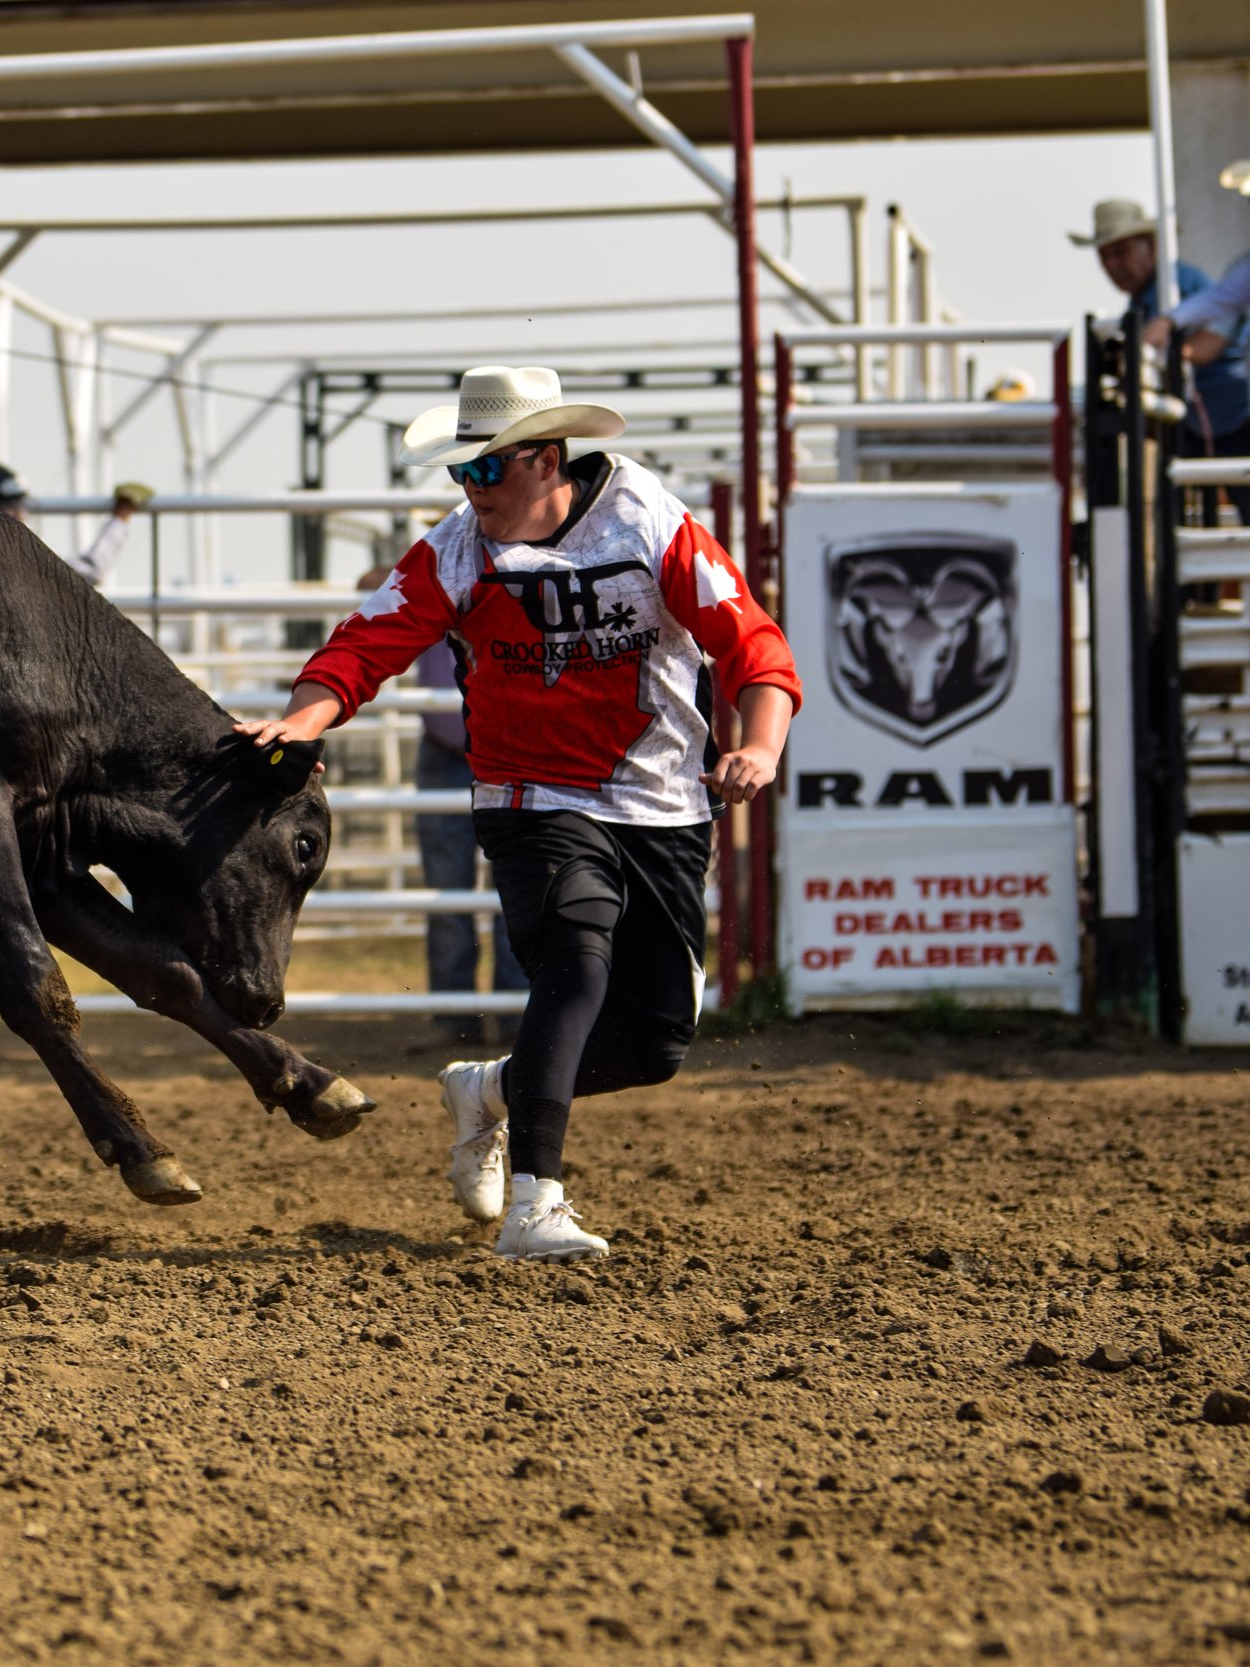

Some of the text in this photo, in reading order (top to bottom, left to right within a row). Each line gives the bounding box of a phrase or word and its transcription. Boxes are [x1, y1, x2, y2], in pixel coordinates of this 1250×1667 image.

[491, 628, 660, 663] CROOKED HORN
[503, 650, 650, 677] COWBOY PROTECTION
[797, 766, 1053, 809] RAM
[804, 873, 1050, 900] RAM TRUCK
[833, 909, 1023, 936] DEALERS
[803, 944, 1059, 971] OF ALBERTA
